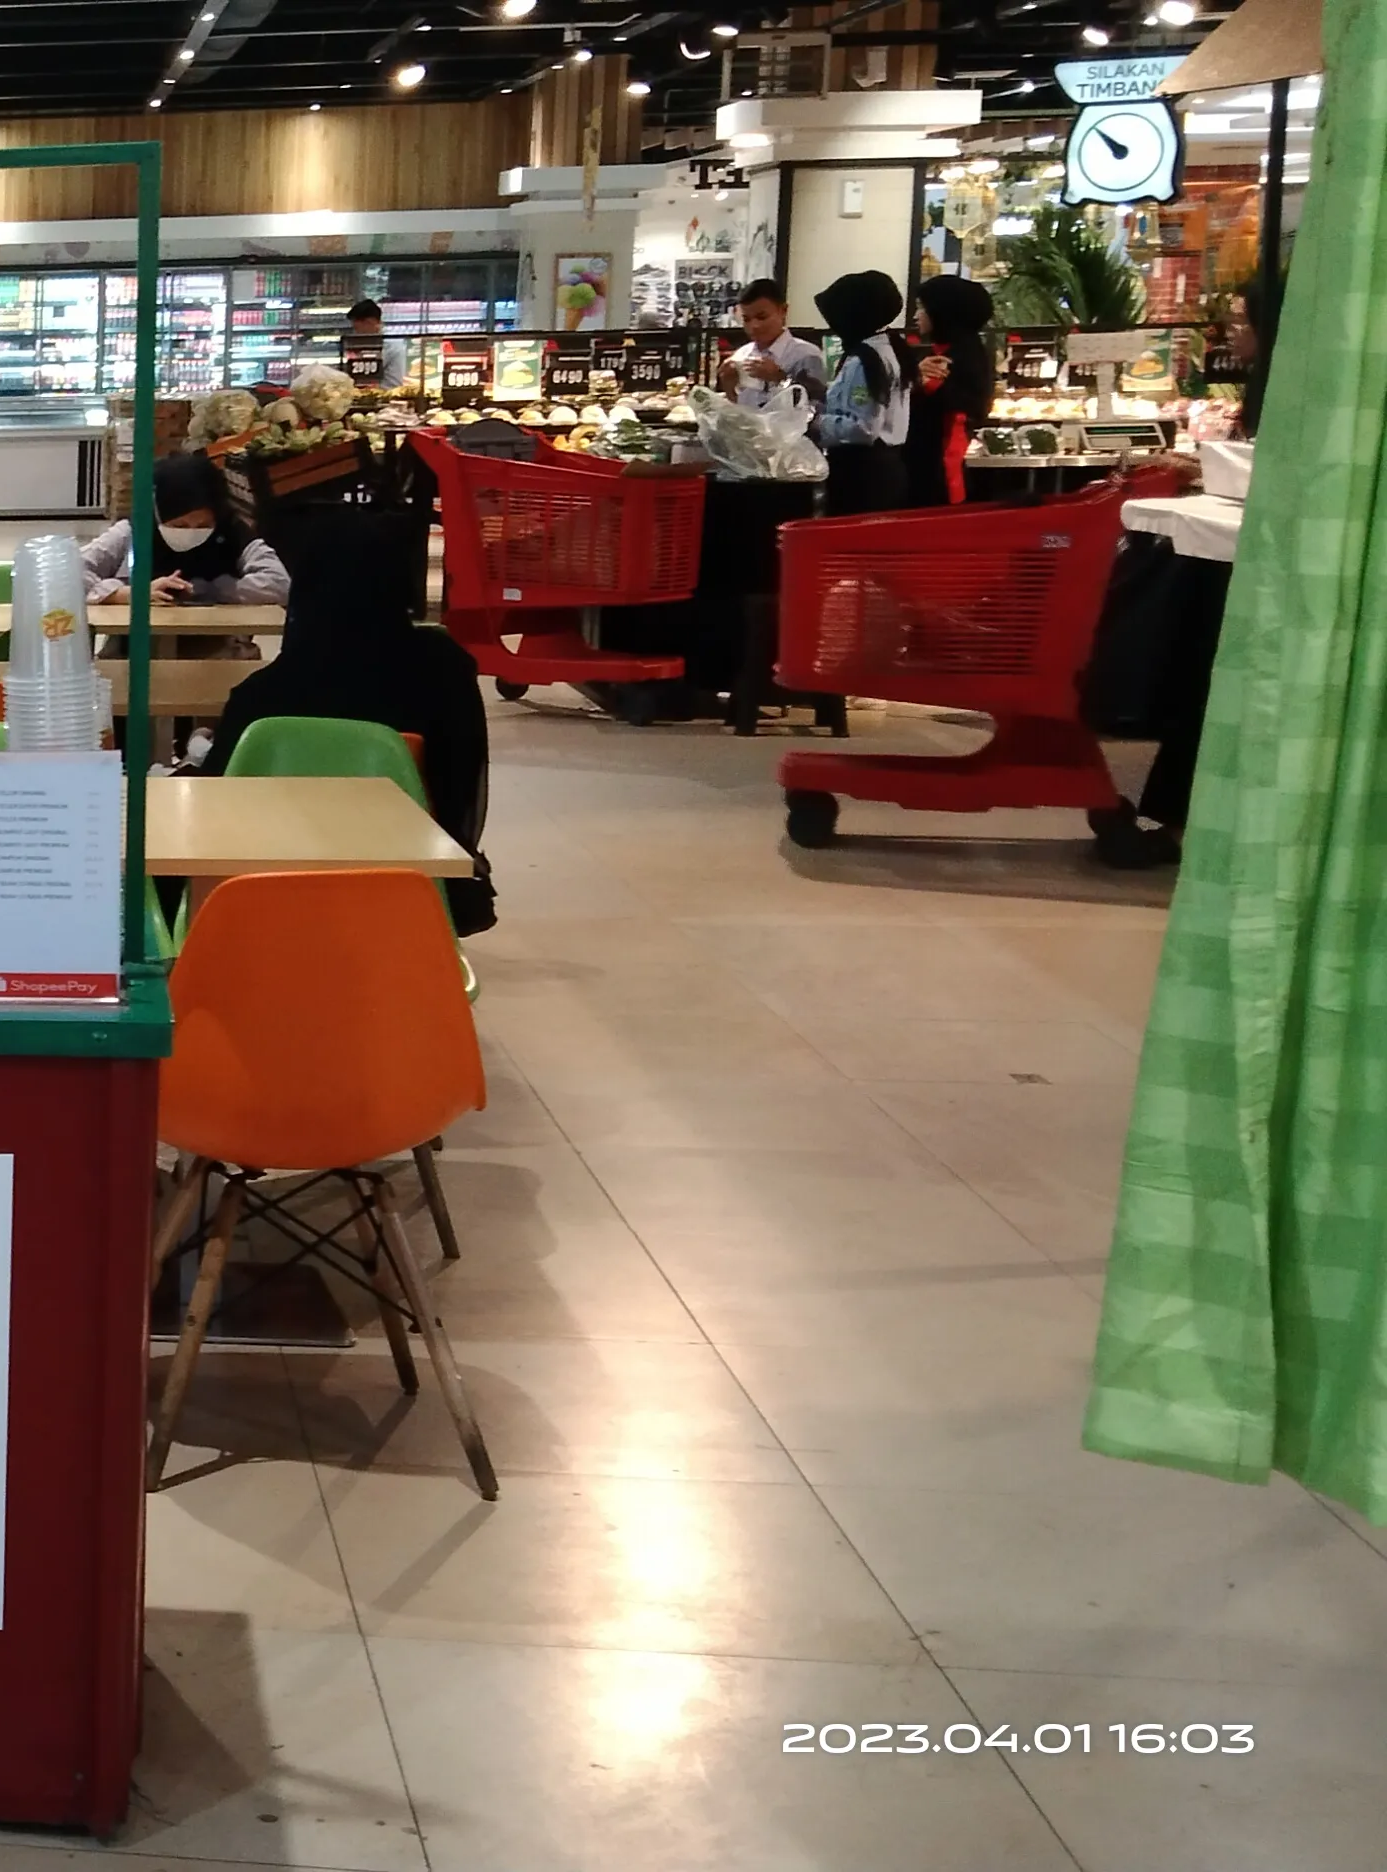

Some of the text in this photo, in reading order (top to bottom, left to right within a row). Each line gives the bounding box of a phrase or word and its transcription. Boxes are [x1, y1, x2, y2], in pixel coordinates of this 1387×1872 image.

[1086, 62, 1165, 80] SILAKAN
[1076, 80, 1158, 98] TIMBAN
[10, 980, 98, 995] ShopeePay
